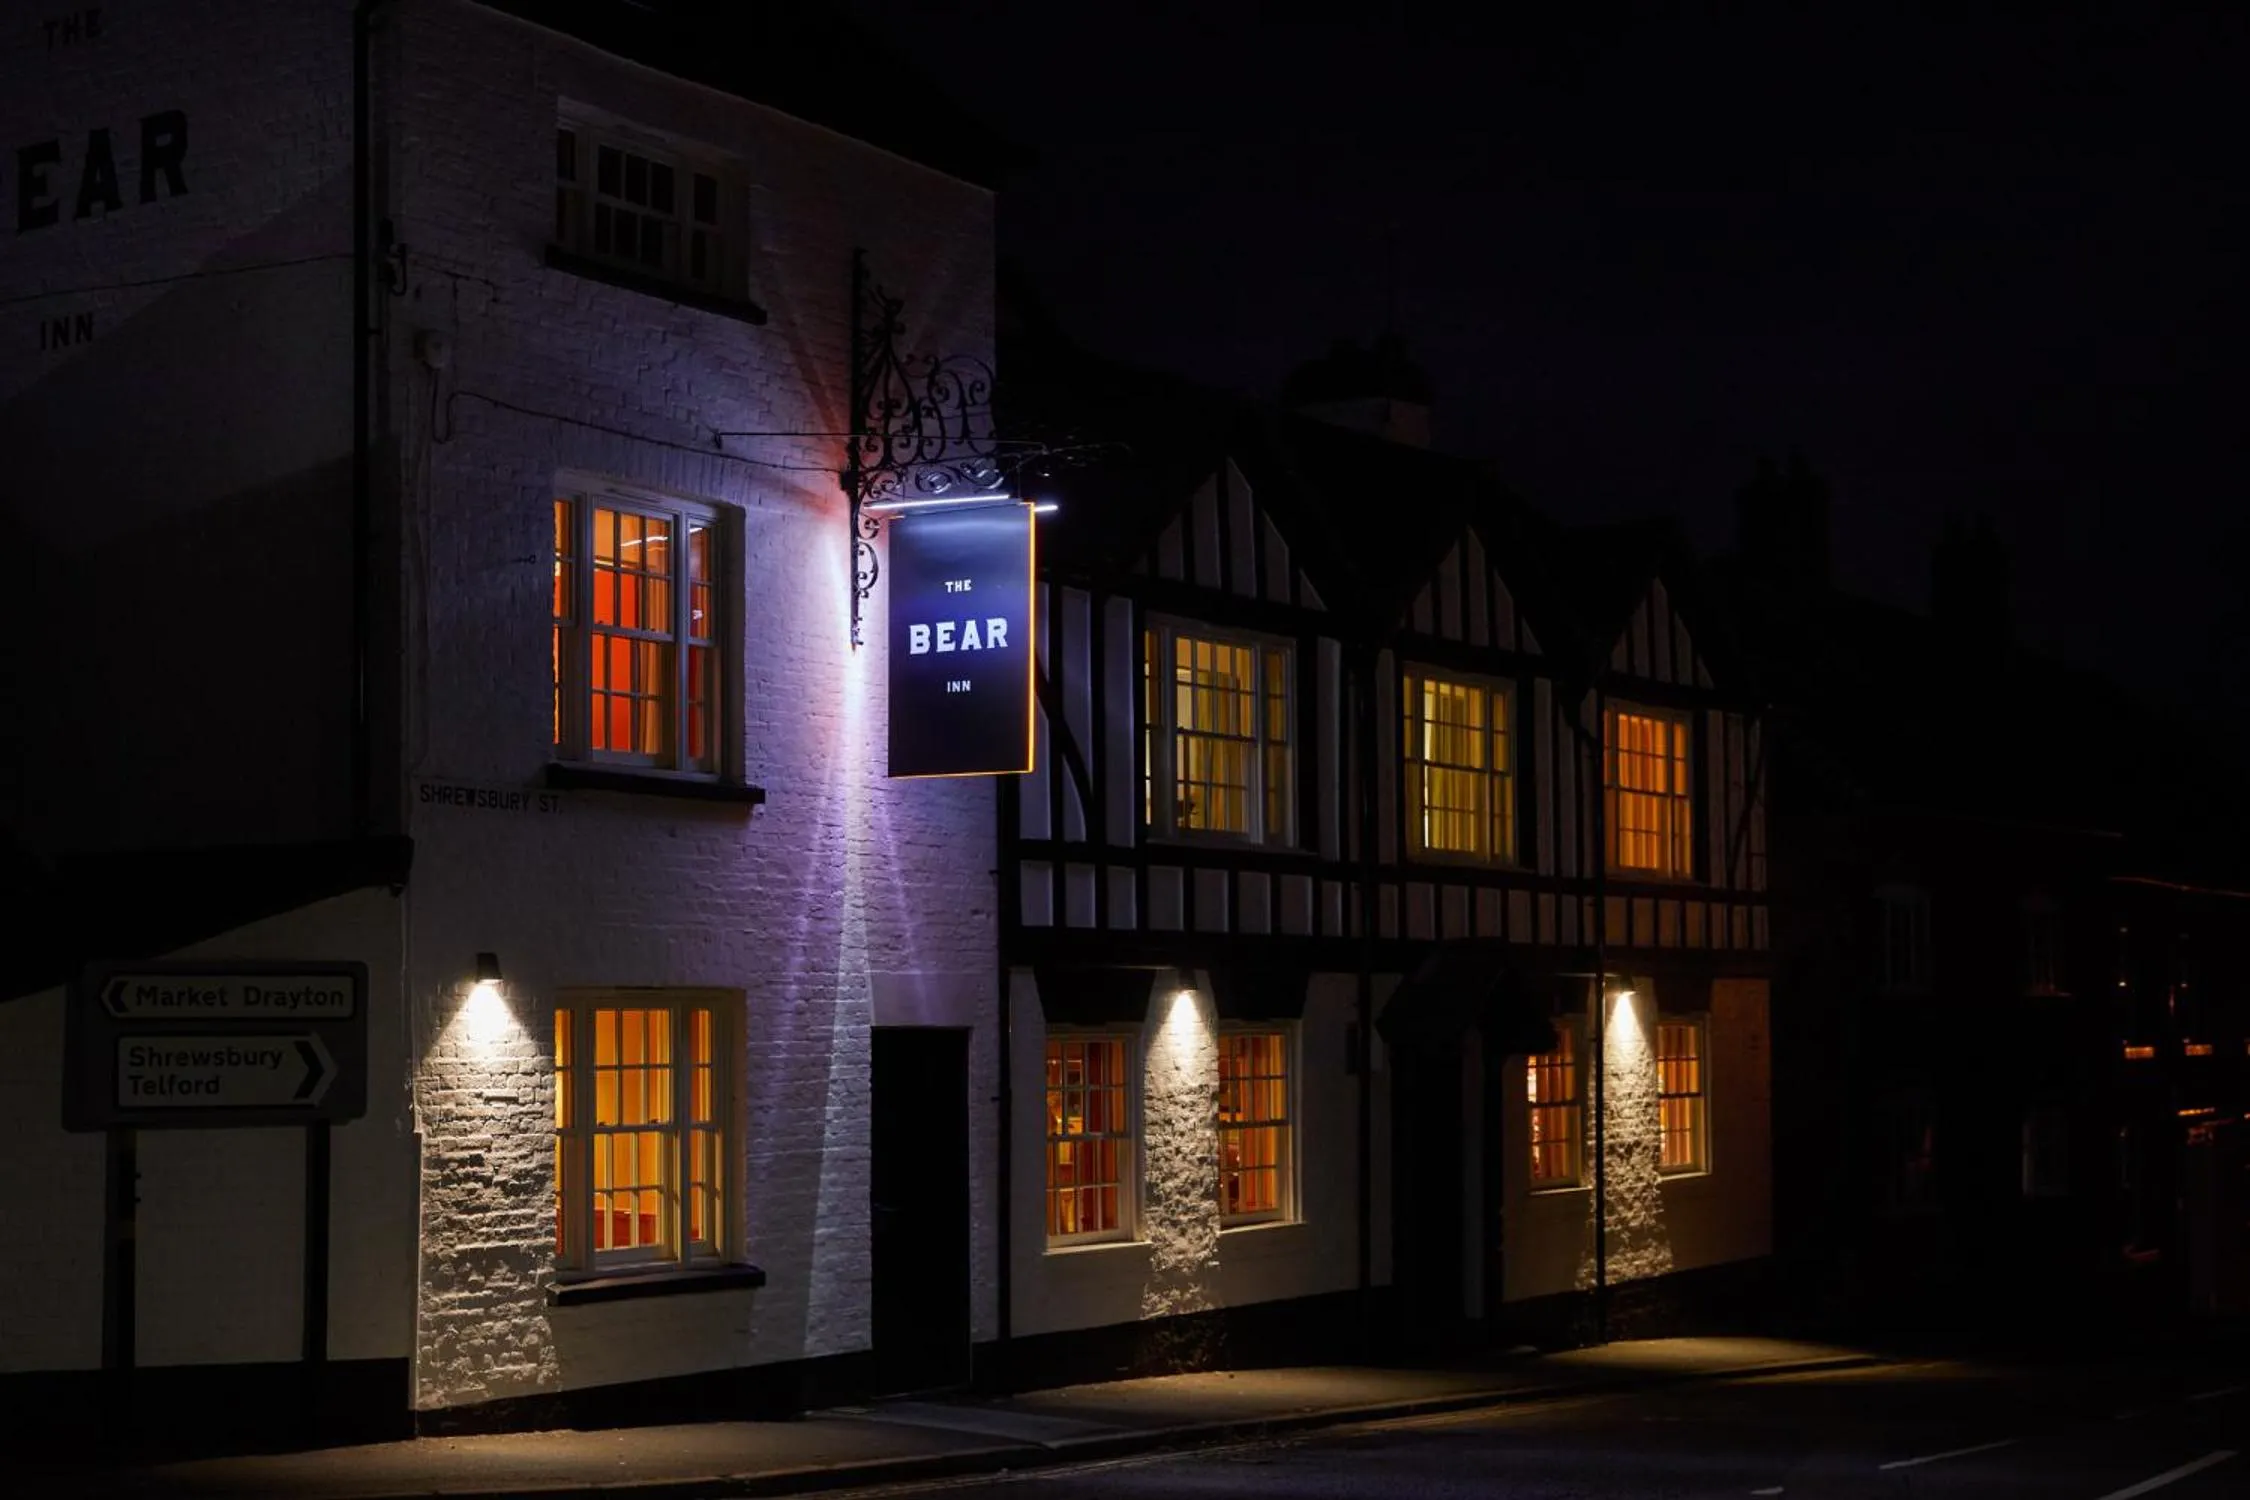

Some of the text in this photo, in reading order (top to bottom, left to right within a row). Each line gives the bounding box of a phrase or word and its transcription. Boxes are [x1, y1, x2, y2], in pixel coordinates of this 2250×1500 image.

[43, 9, 101, 52] THE
[16, 109, 188, 235] EAR
[40, 313, 93, 350] INN
[945, 579, 972, 593] THE
[909, 617, 1009, 655] BEAR
[947, 680, 971, 693] INN
[420, 784, 531, 811] SHREWSBURY
[136, 986, 344, 1010] Market Drayton
[129, 1047, 283, 1070] Shrewsbury
[128, 1074, 220, 1096] Telford
